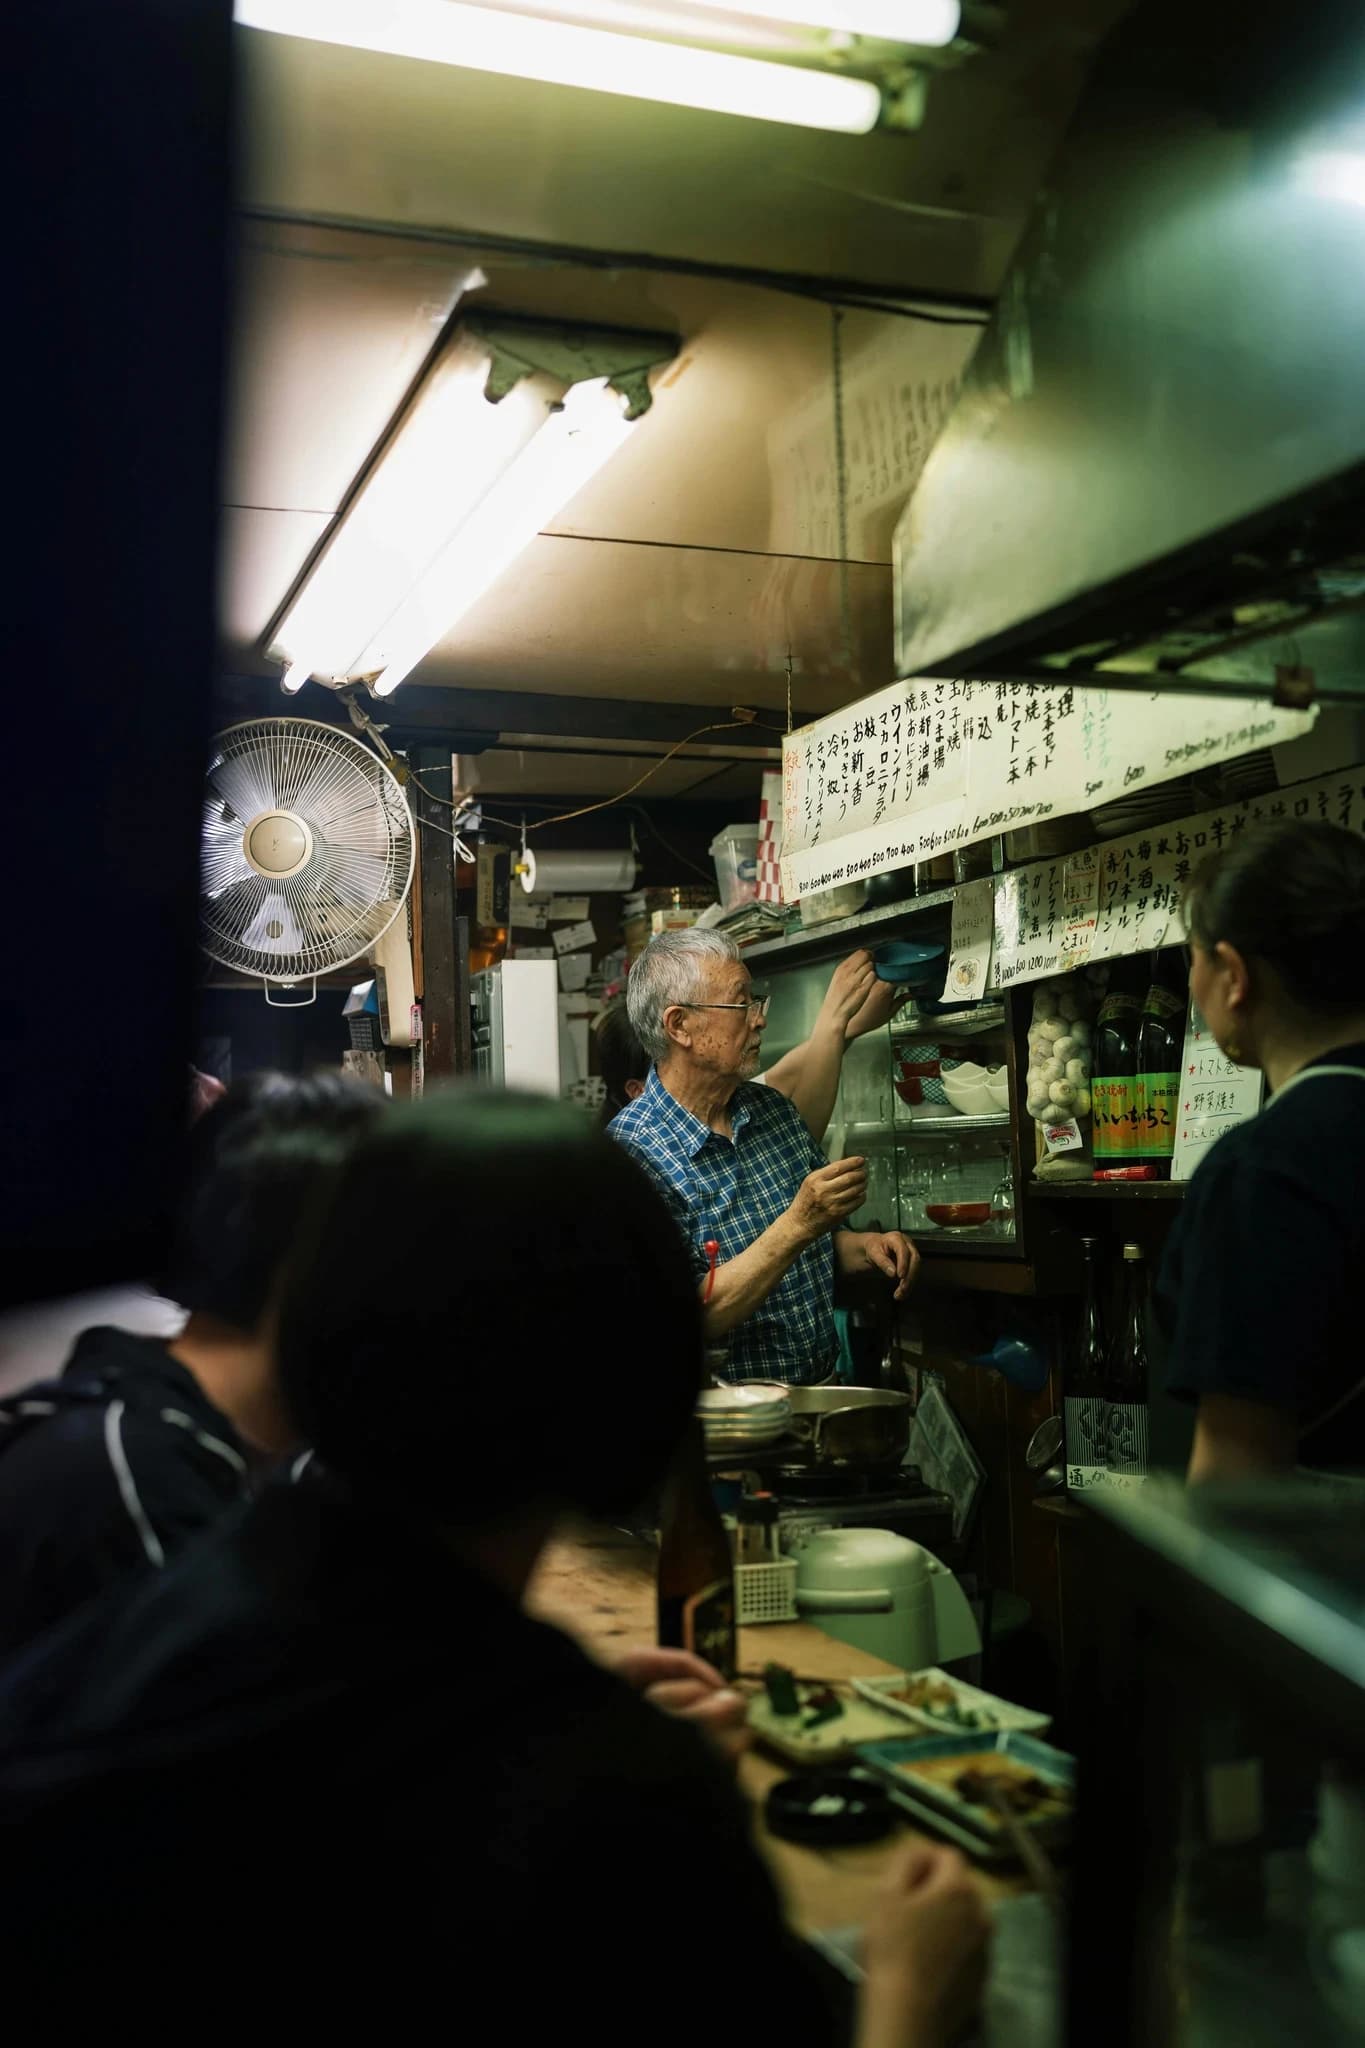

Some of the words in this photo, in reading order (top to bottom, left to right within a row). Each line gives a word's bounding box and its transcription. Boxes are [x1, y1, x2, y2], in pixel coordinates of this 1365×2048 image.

[851, 719, 867, 807] お新香
[872, 711, 889, 826] マカロニサラダ
[890, 703, 902, 804] ウインナー
